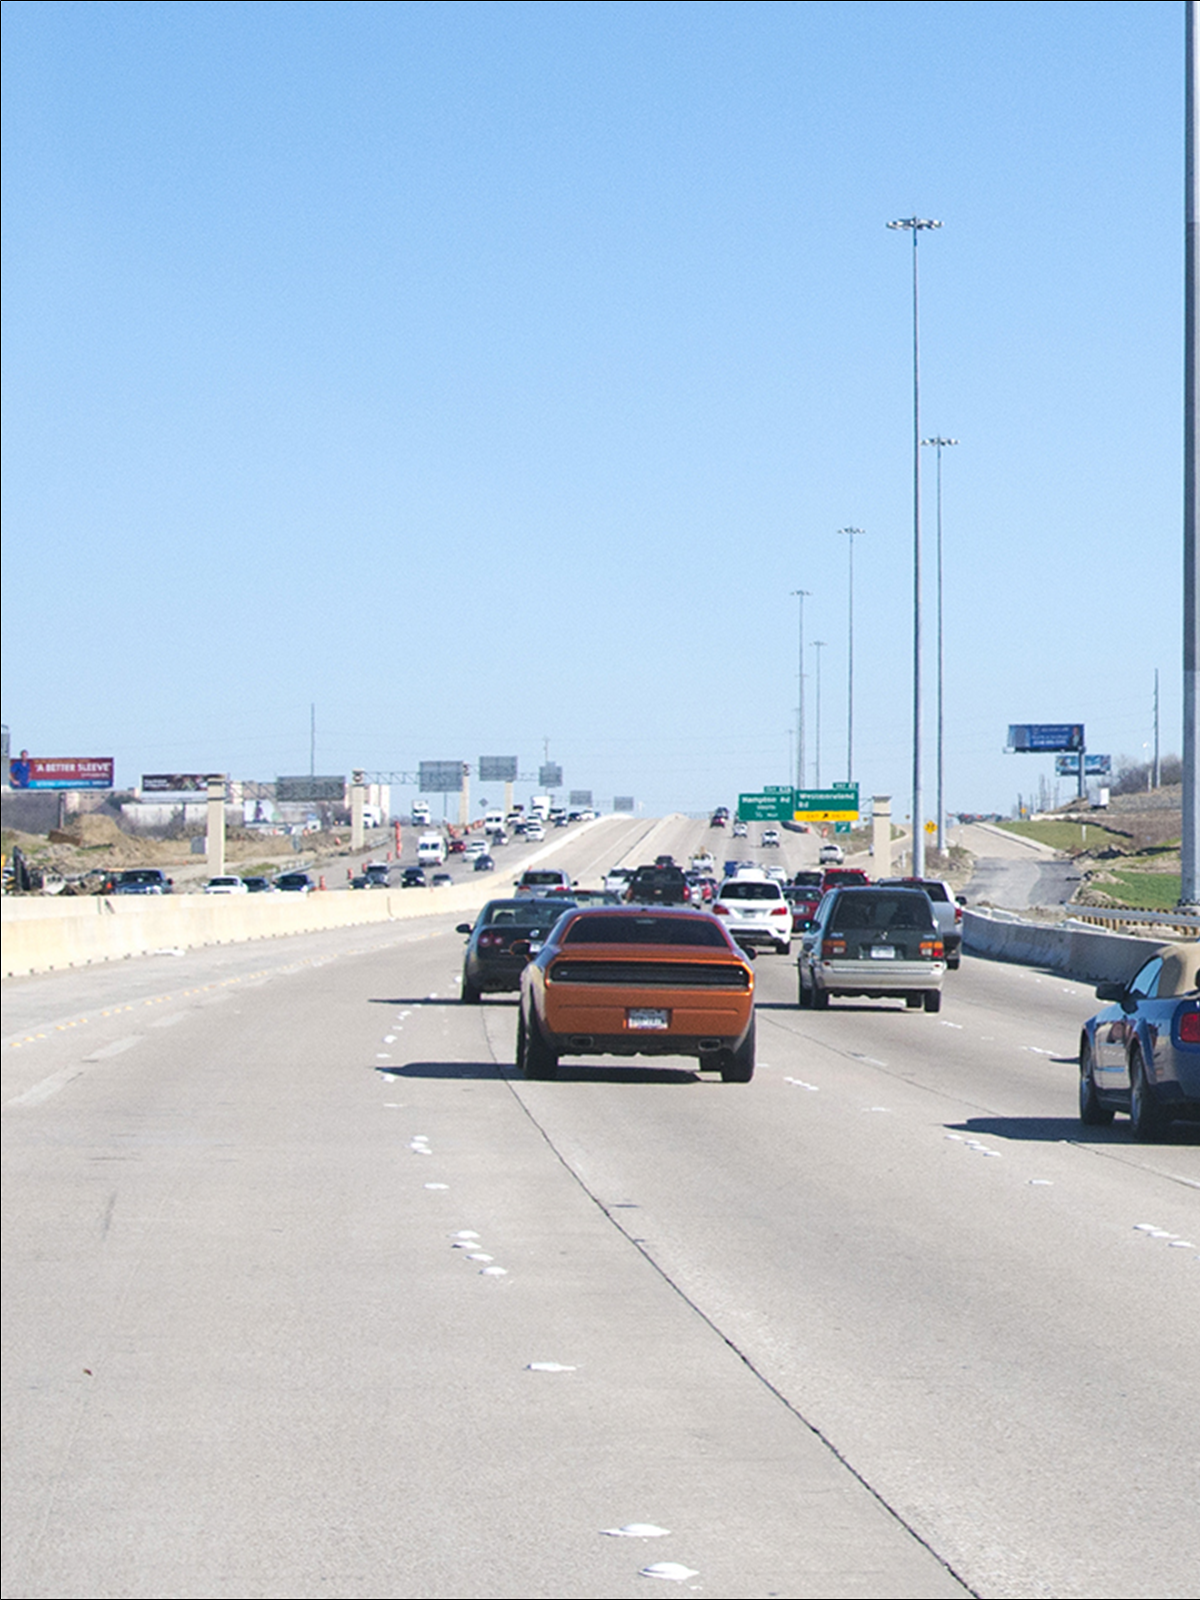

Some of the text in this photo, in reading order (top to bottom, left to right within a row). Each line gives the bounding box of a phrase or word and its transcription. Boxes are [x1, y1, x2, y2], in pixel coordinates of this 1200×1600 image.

[46, 763, 75, 771] BETTER
[742, 796, 777, 804] Hampton
[798, 801, 809, 809] Rd
